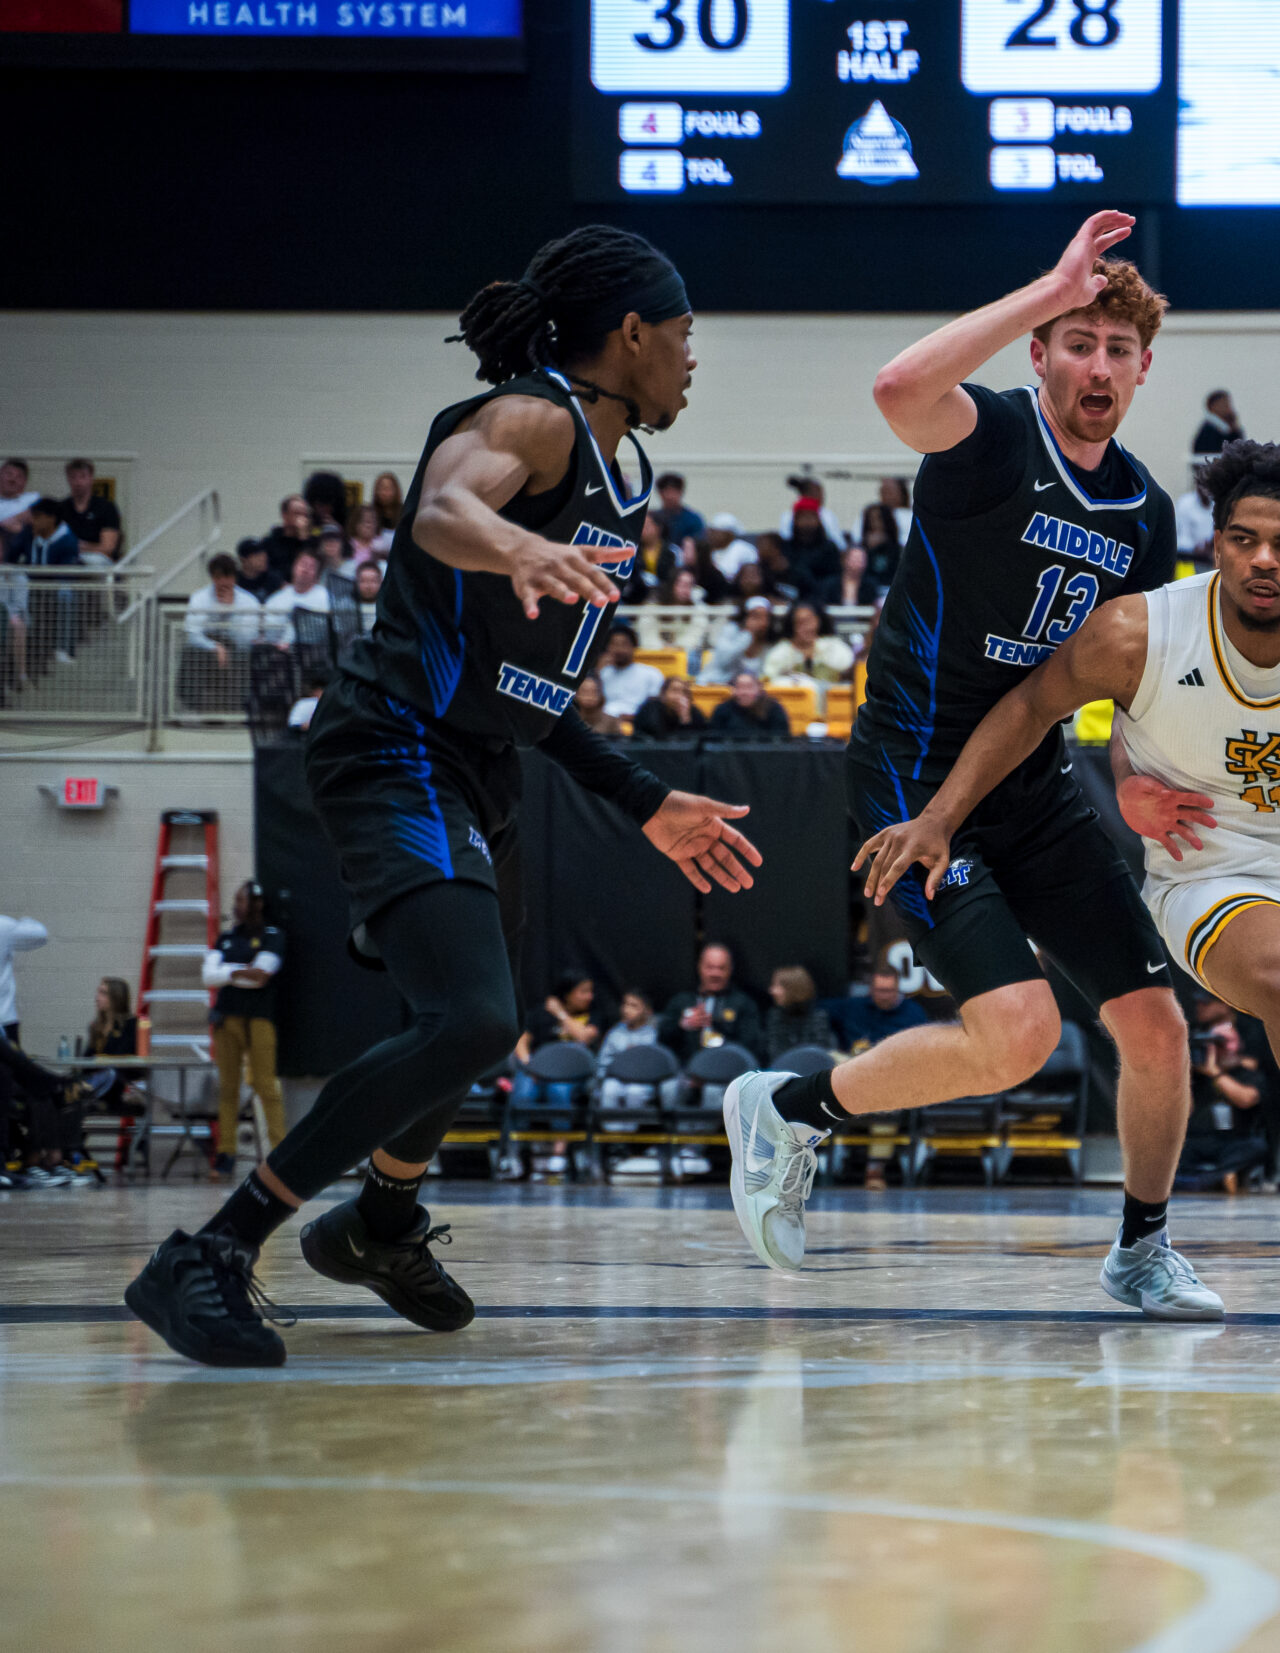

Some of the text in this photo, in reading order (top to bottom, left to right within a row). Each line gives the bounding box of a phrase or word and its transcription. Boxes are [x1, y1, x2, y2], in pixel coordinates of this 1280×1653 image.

[188, 2, 467, 28] HEALTH SYSTEM
[633, 0, 750, 51] 30
[1004, 0, 1121, 48] 28
[846, 20, 910, 51] 1ST
[837, 50, 921, 82] HALF
[684, 110, 763, 138] FOULS
[1055, 106, 1132, 134] FOULS
[685, 157, 734, 186] TOL
[1056, 154, 1104, 182] TOL
[1020, 511, 1135, 578] MIDDLE
[1021, 564, 1100, 644] 13
[984, 633, 1058, 666] TENN
